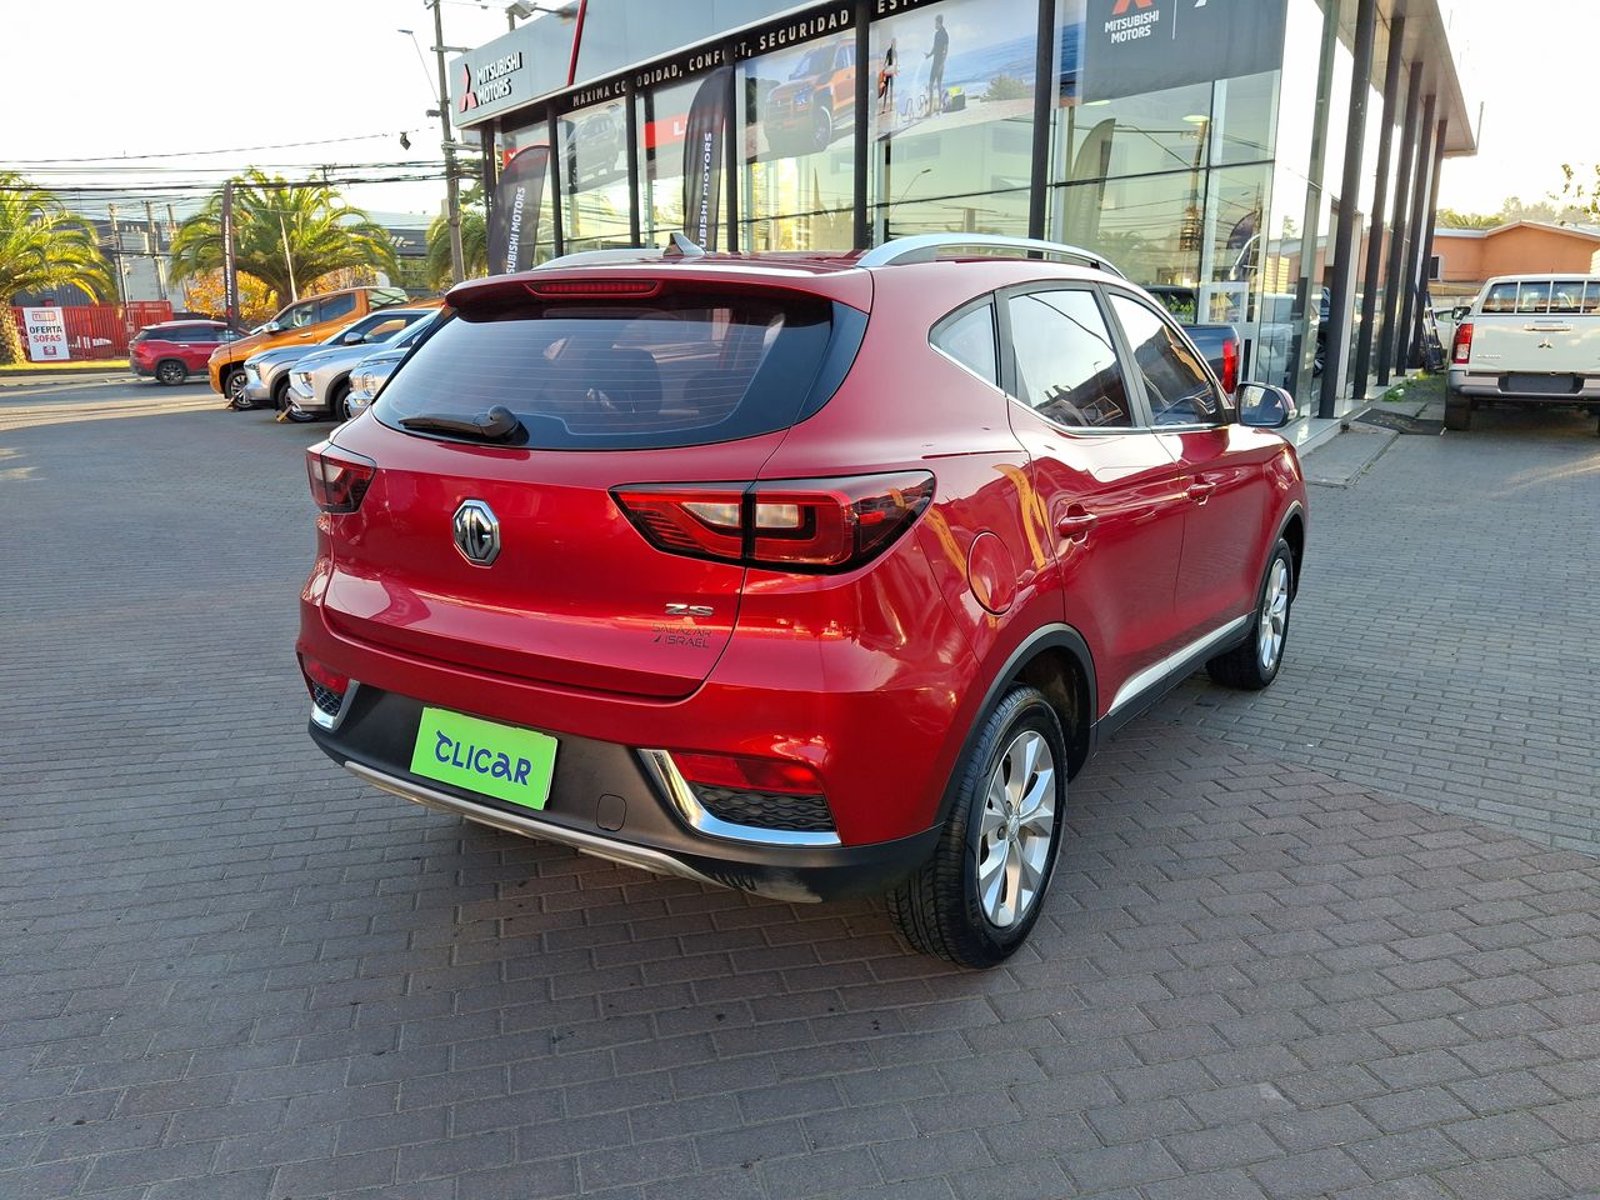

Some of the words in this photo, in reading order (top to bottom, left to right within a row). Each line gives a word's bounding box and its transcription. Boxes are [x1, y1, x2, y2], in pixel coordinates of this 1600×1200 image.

[1104, 10, 1159, 33] MITSUBISHI
[1110, 25, 1151, 44] MOTORS
[614, 64, 682, 94] COODIDAD,
[689, 42, 752, 71] CONFT,
[759, 9, 849, 50] SEGURIDAD
[476, 51, 522, 85] MITSUBISHI
[478, 78, 511, 105] MOTORS
[703, 131, 712, 196] MOTORS
[512, 186, 526, 232] MOTORS
[699, 200, 708, 250] UBISHI
[29, 325, 62, 335] OFERTA
[455, 506, 493, 560] MG
[665, 603, 714, 616] ZS
[665, 635, 709, 649] ISRAEL
